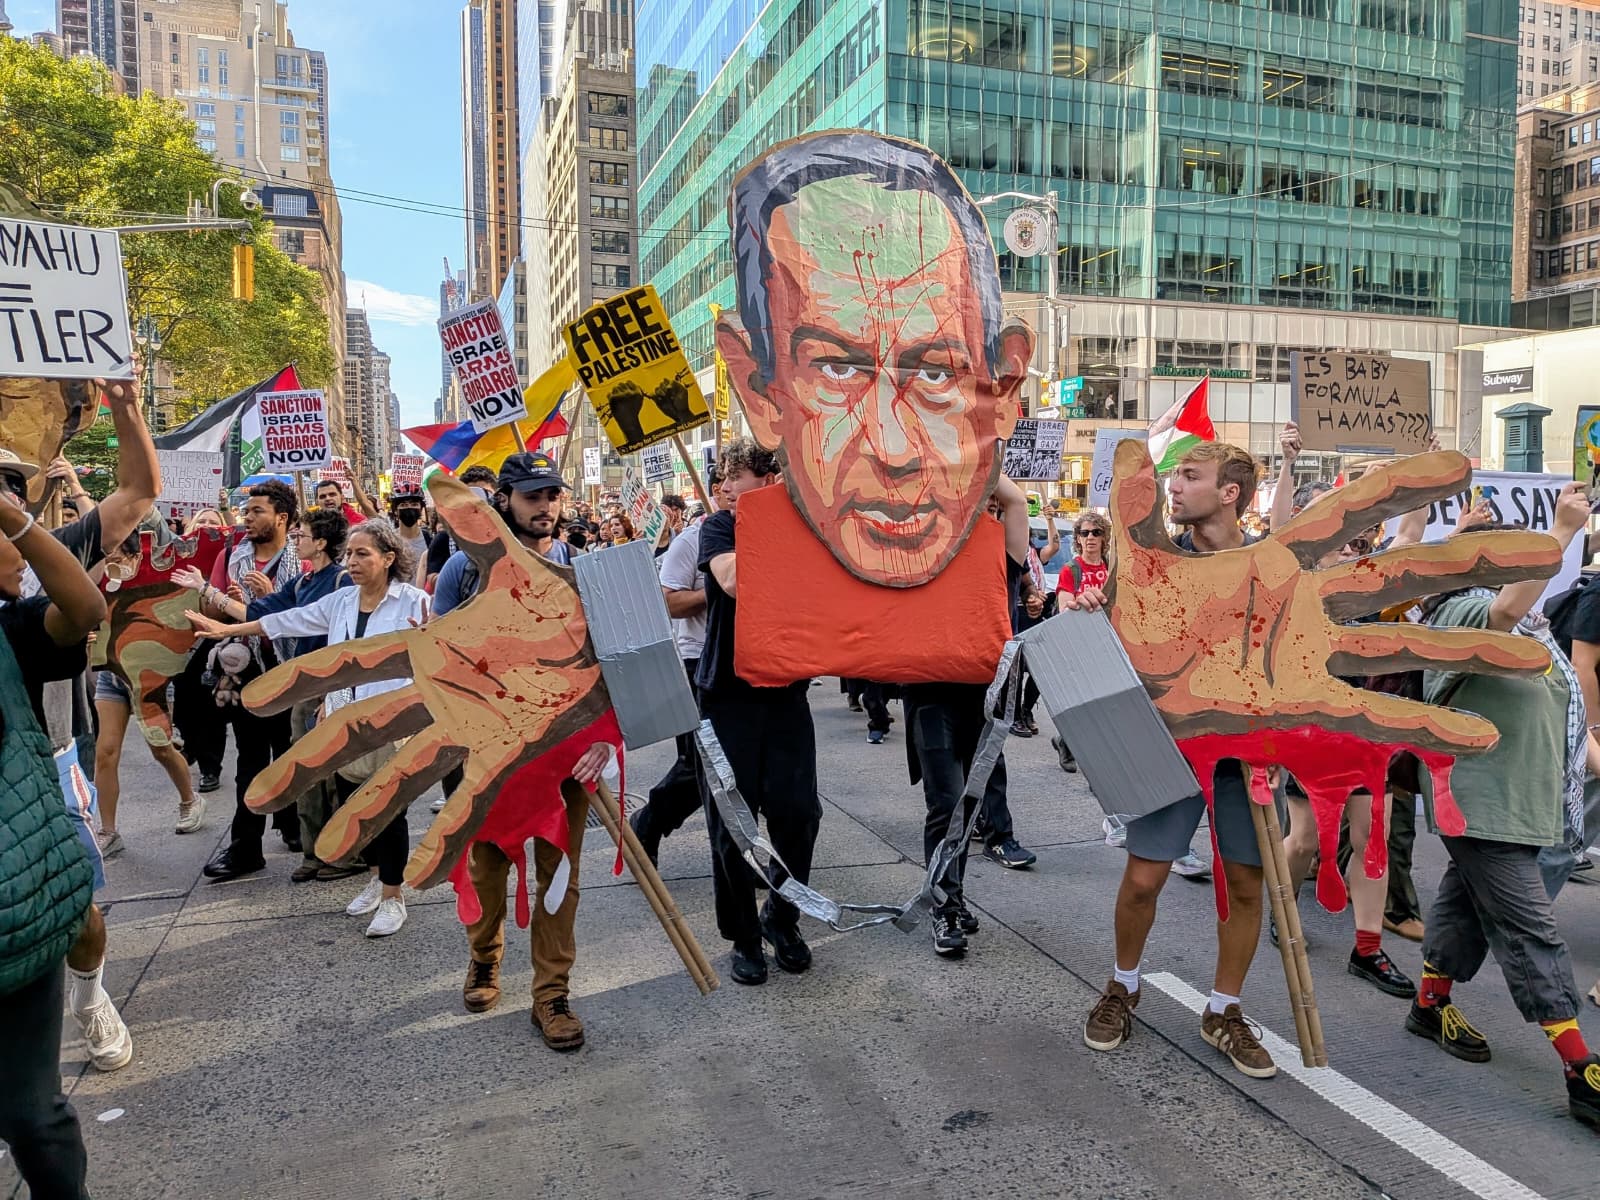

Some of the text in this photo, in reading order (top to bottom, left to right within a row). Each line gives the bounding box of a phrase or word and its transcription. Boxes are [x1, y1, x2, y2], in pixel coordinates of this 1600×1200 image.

[441, 309, 502, 351] SANCTION
[568, 287, 663, 365] FREE
[449, 334, 505, 366] ISRAEL
[457, 348, 511, 380] ARMS
[577, 329, 680, 388] PALESTINE
[1304, 355, 1390, 380] IS BABY
[462, 364, 518, 404] EMBARGO
[1483, 373, 1523, 386] Subway
[1305, 381, 1401, 408] FORMULA
[260, 397, 322, 415] SANCTION
[470, 387, 524, 421] NOW
[263, 413, 323, 425] ISRAEL
[1016, 421, 1038, 429] RAEL
[1040, 421, 1065, 430] ISRAEL
[266, 423, 324, 436] ARMS
[266, 434, 326, 451] EMBARGO
[1010, 440, 1032, 448] GAZA
[1040, 440, 1060, 449] GAZA
[269, 448, 326, 464] NOW
[394, 456, 423, 465] SANCTION
[643, 453, 670, 466] FREE
[645, 462, 672, 474] PALESTINE
